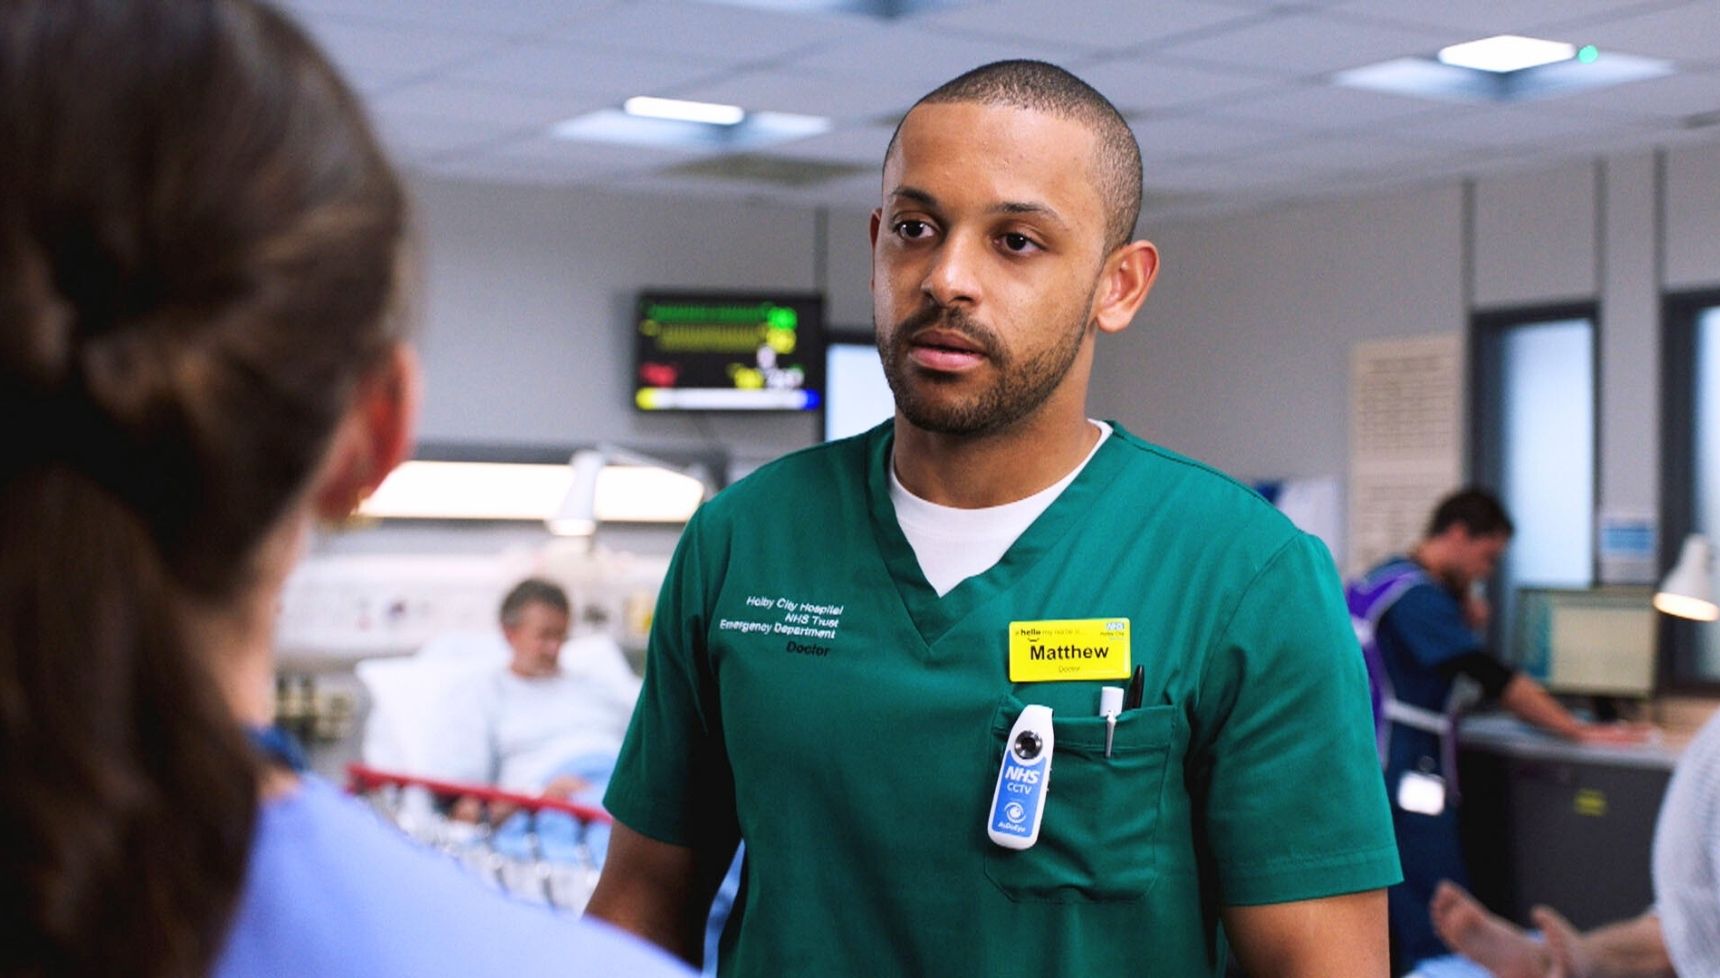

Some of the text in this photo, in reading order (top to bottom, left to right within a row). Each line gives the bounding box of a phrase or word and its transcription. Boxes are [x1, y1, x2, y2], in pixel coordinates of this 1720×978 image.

[746, 596, 844, 616] Holby City Hospital
[784, 612, 840, 628] NHS Trust
[719, 619, 836, 639] Emergency Department
[1020, 628, 1041, 636] hello
[786, 641, 830, 656] Doctor
[1030, 644, 1109, 661] Matthew
[1005, 766, 1040, 784] NHS
[1007, 783, 1032, 794] CCTV
